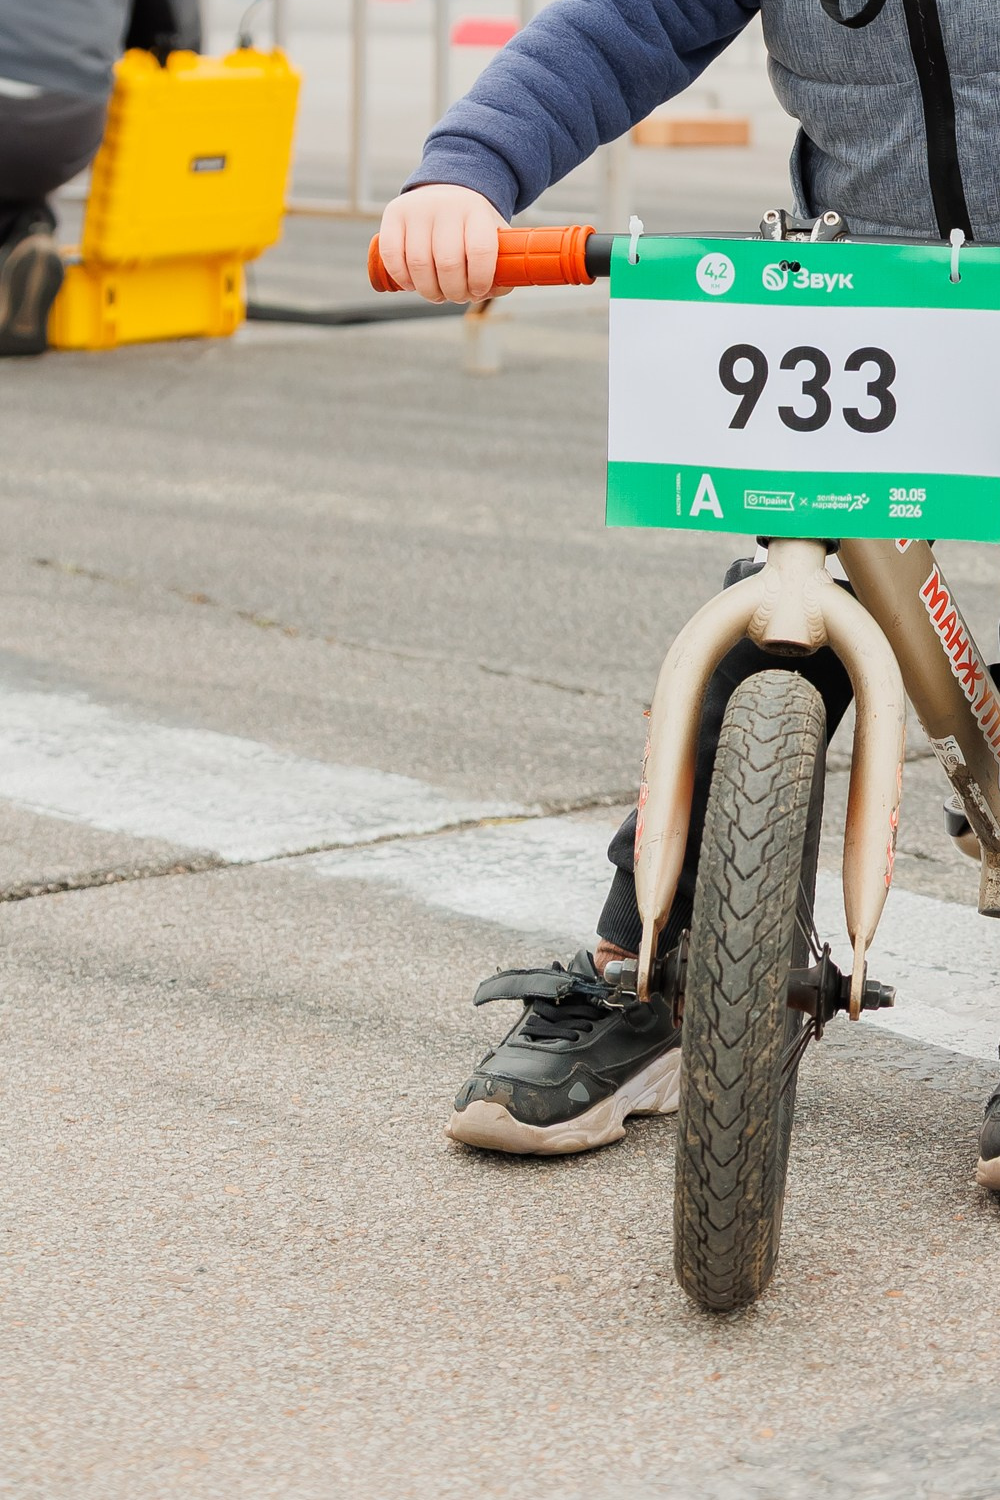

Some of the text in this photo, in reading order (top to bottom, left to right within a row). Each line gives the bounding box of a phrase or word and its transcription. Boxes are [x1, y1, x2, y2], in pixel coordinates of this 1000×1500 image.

[704, 262, 728, 280] 4,2
[793, 268, 853, 292] Звук
[718, 343, 896, 433] 933
[758, 496, 787, 506] Прайм
[889, 488, 926, 502] 30.05
[812, 502, 849, 510] марафон
[889, 504, 922, 518] 2026
